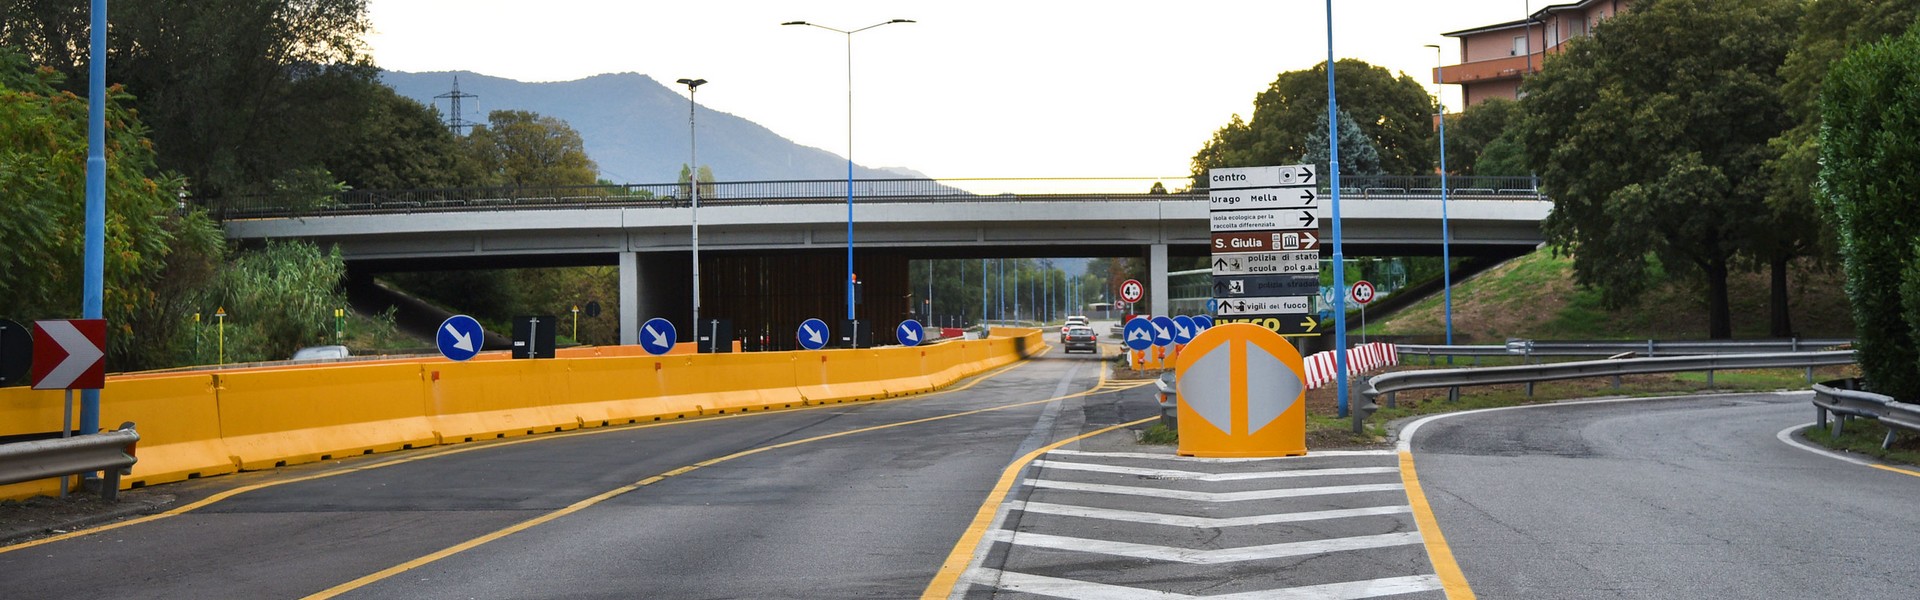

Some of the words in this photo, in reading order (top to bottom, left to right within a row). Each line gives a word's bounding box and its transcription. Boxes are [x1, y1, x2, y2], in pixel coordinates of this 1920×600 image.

[1212, 173, 1246, 181] centro
[1211, 196, 1241, 204] Urago
[1215, 238, 1227, 248] S.
[1231, 238, 1262, 247] Giulia
[1248, 254, 1276, 262] polizia
[1282, 253, 1290, 261] di
[1246, 302, 1266, 311] vigili
